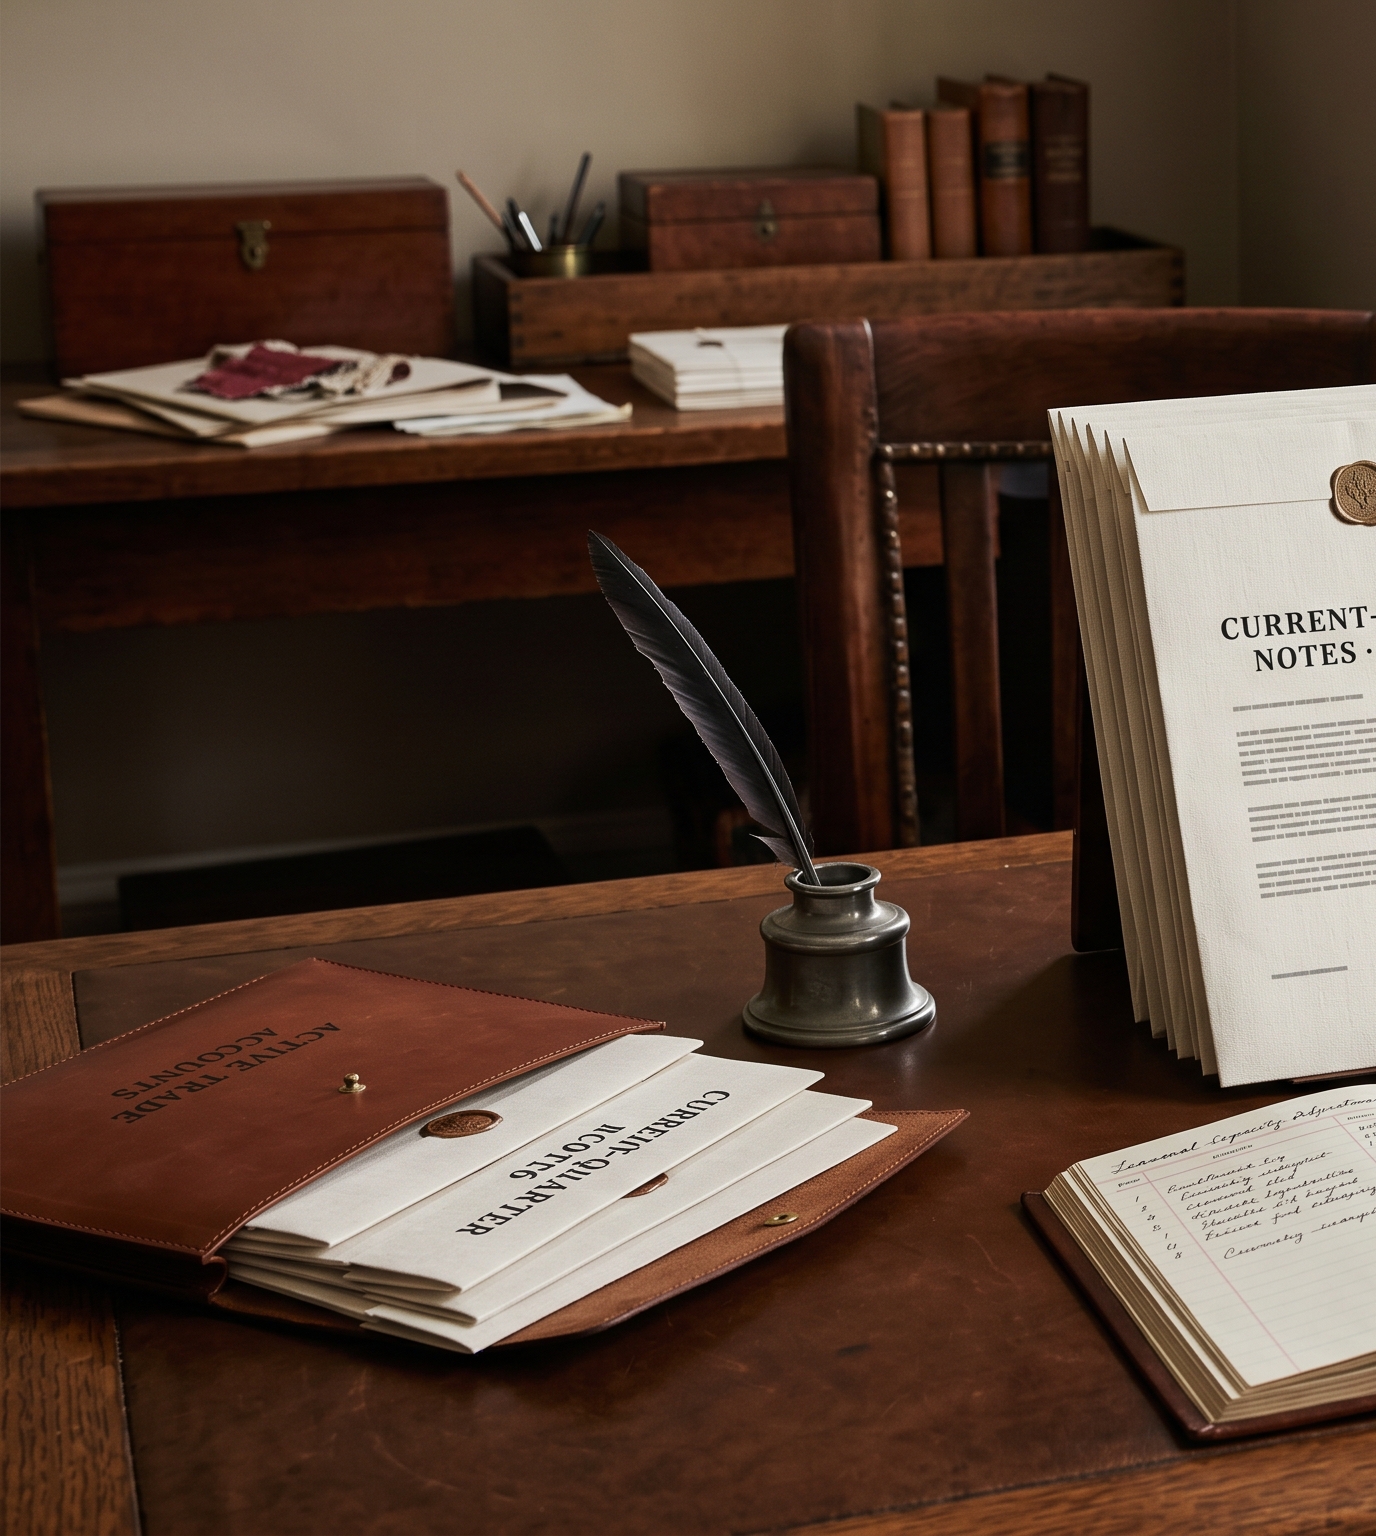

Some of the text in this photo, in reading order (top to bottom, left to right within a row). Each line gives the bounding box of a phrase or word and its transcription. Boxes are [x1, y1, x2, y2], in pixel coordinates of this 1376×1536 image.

[1253, 640, 1357, 672] NOTES
[110, 1022, 341, 1124] ACTIVE TRADE
[111, 1027, 278, 1100] ACCOUNTS
